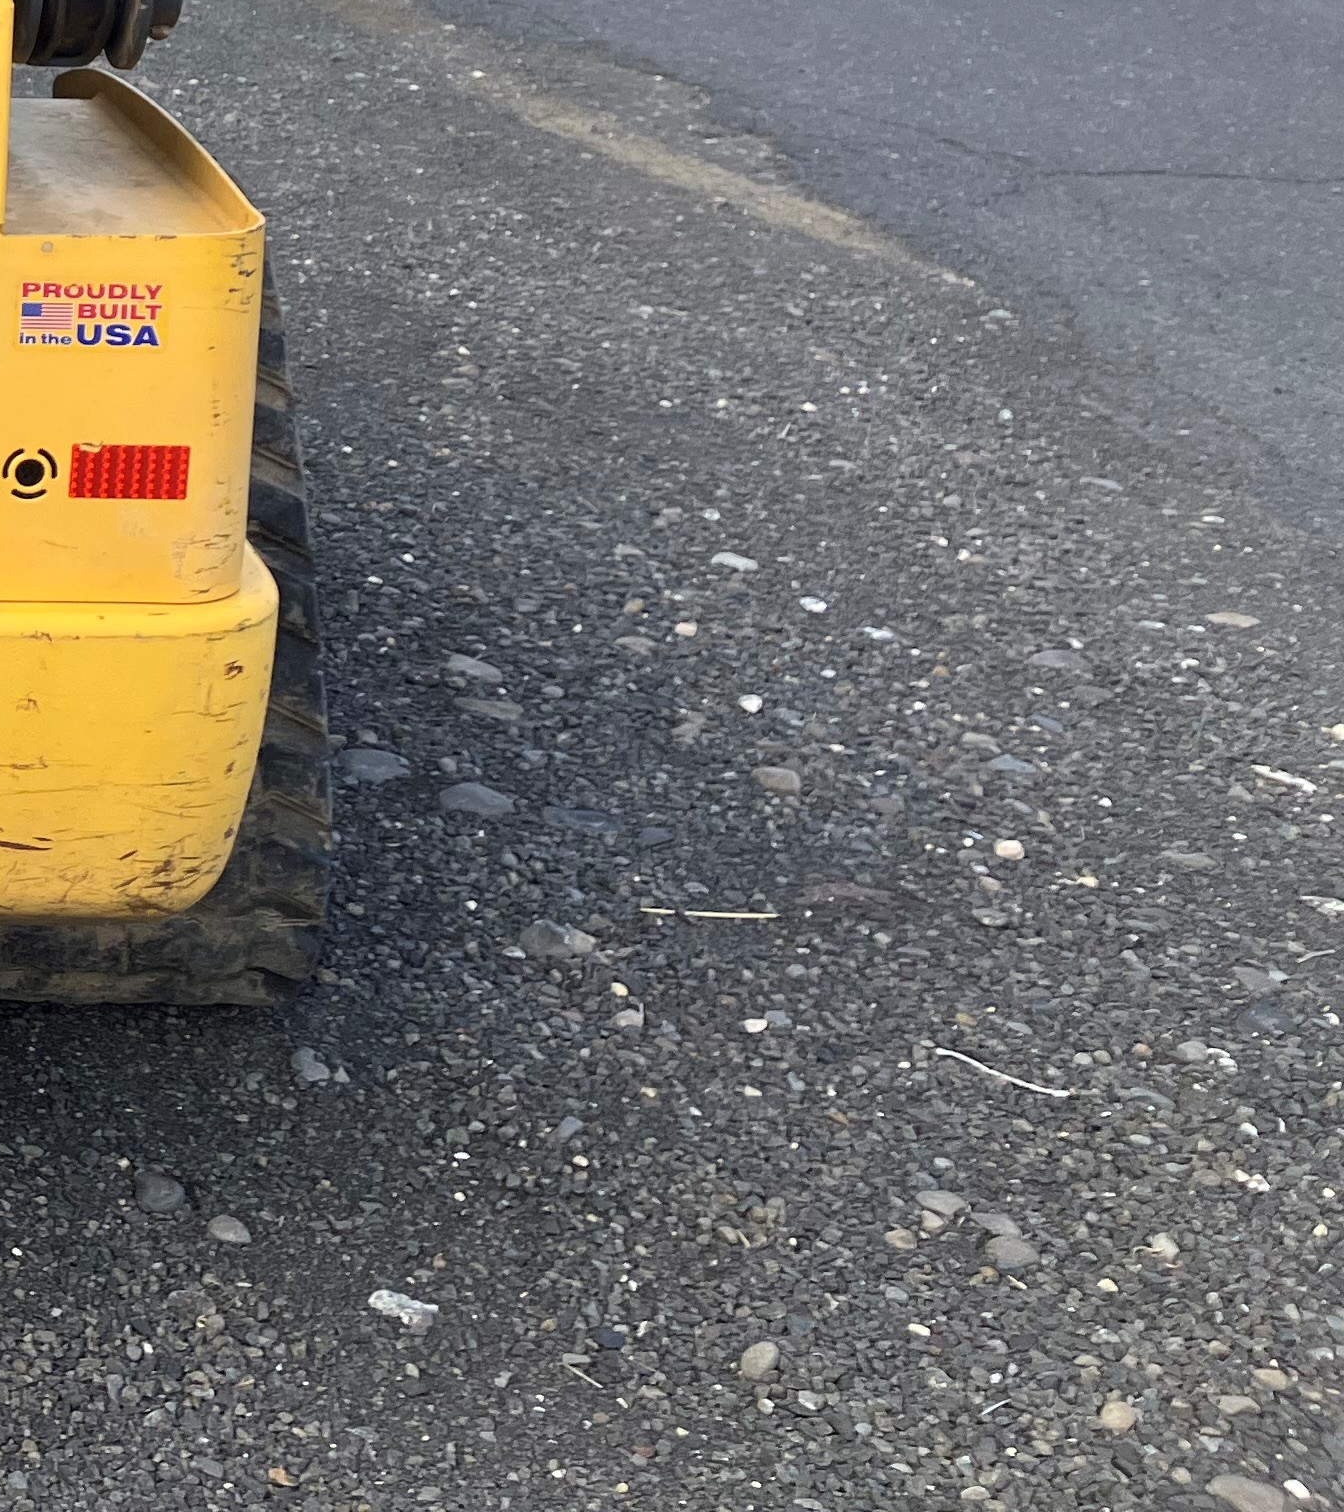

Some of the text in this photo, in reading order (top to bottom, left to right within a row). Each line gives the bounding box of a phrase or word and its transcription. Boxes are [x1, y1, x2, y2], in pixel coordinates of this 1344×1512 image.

[21, 282, 163, 300] PROUDLY
[77, 303, 162, 320] BUILT
[19, 324, 159, 346] in the USA
